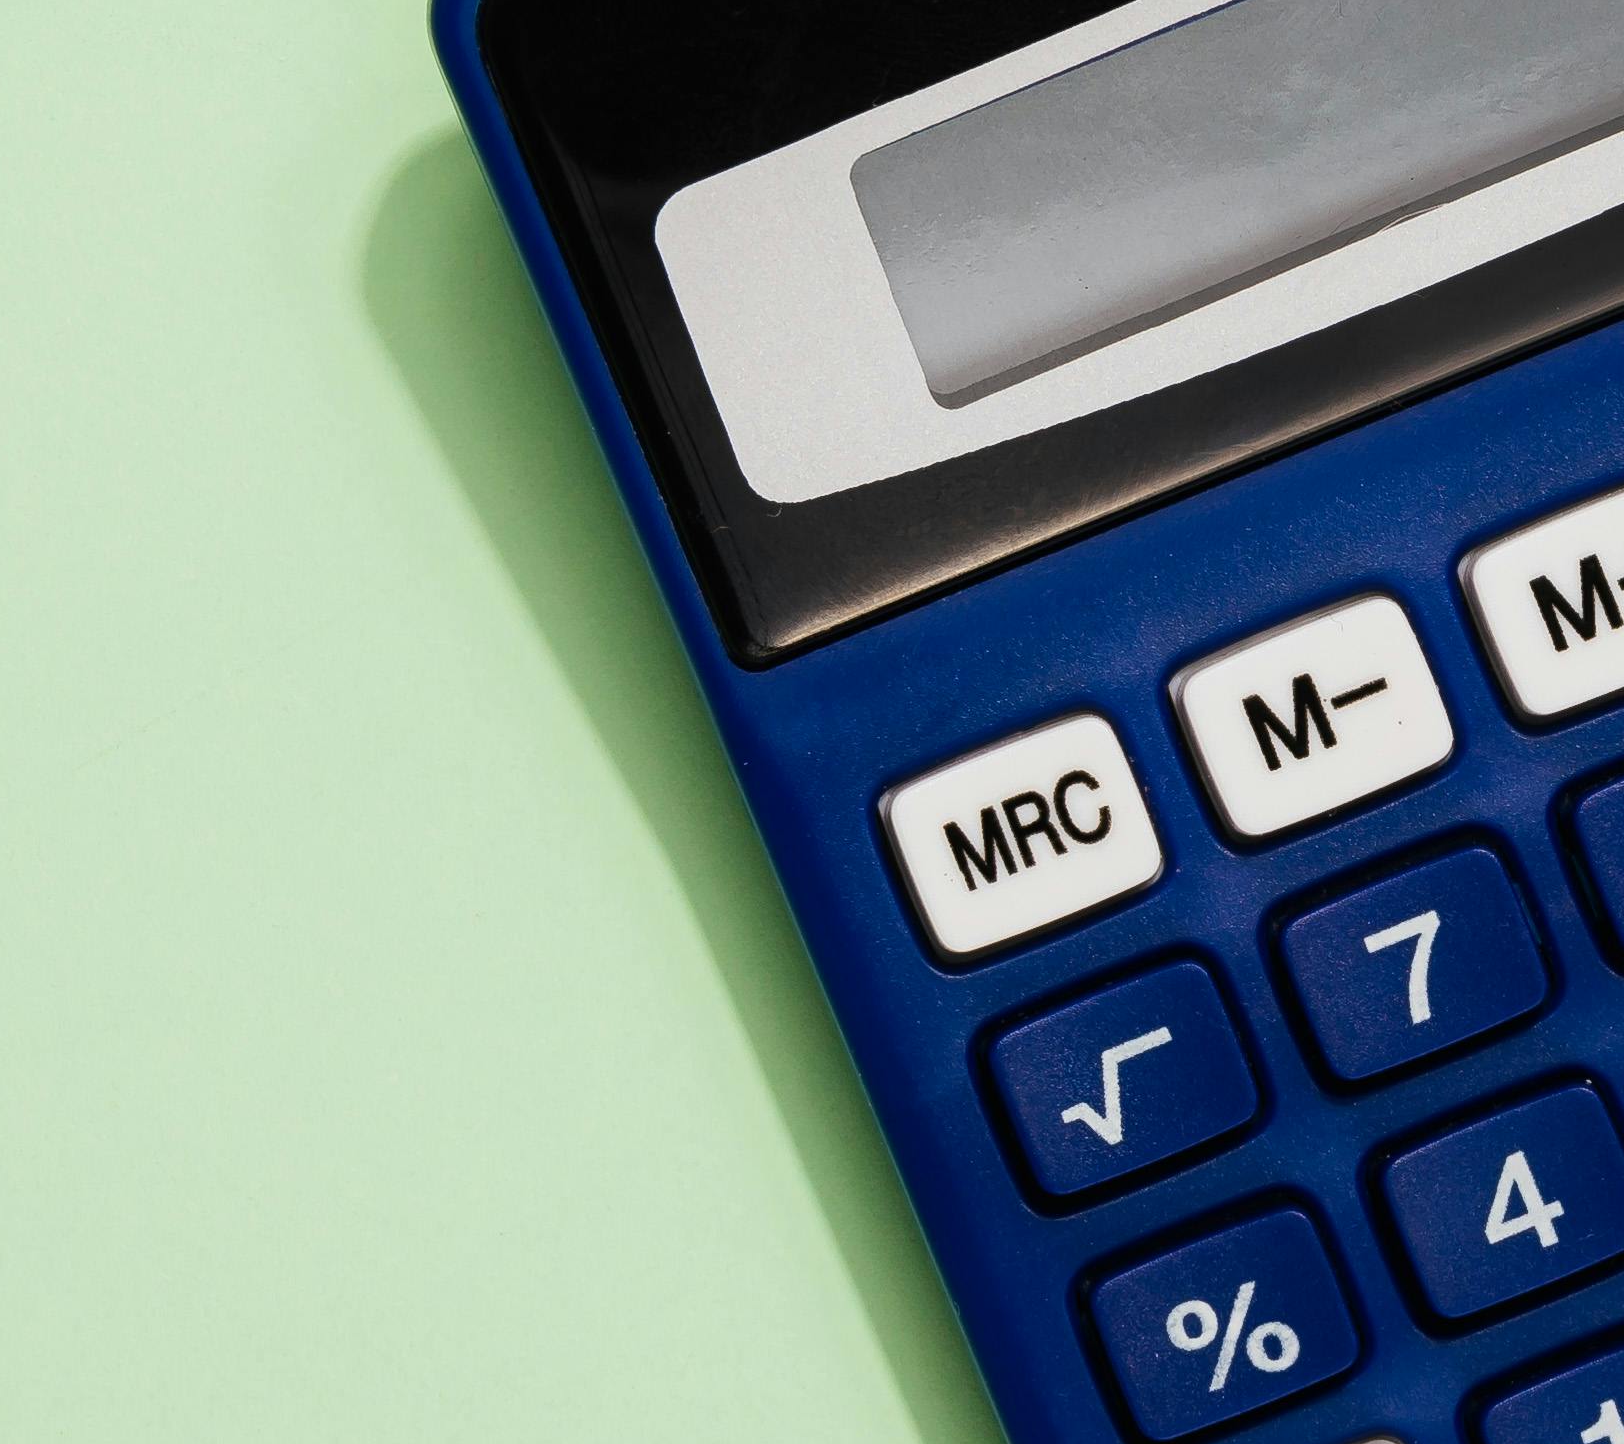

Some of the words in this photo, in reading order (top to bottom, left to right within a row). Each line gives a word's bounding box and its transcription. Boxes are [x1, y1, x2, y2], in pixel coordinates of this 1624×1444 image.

[943, 771, 1111, 891] MRC
[1364, 911, 1440, 1024] 7
[1485, 1151, 1564, 1247] 4
[1166, 1281, 1300, 1391] %
